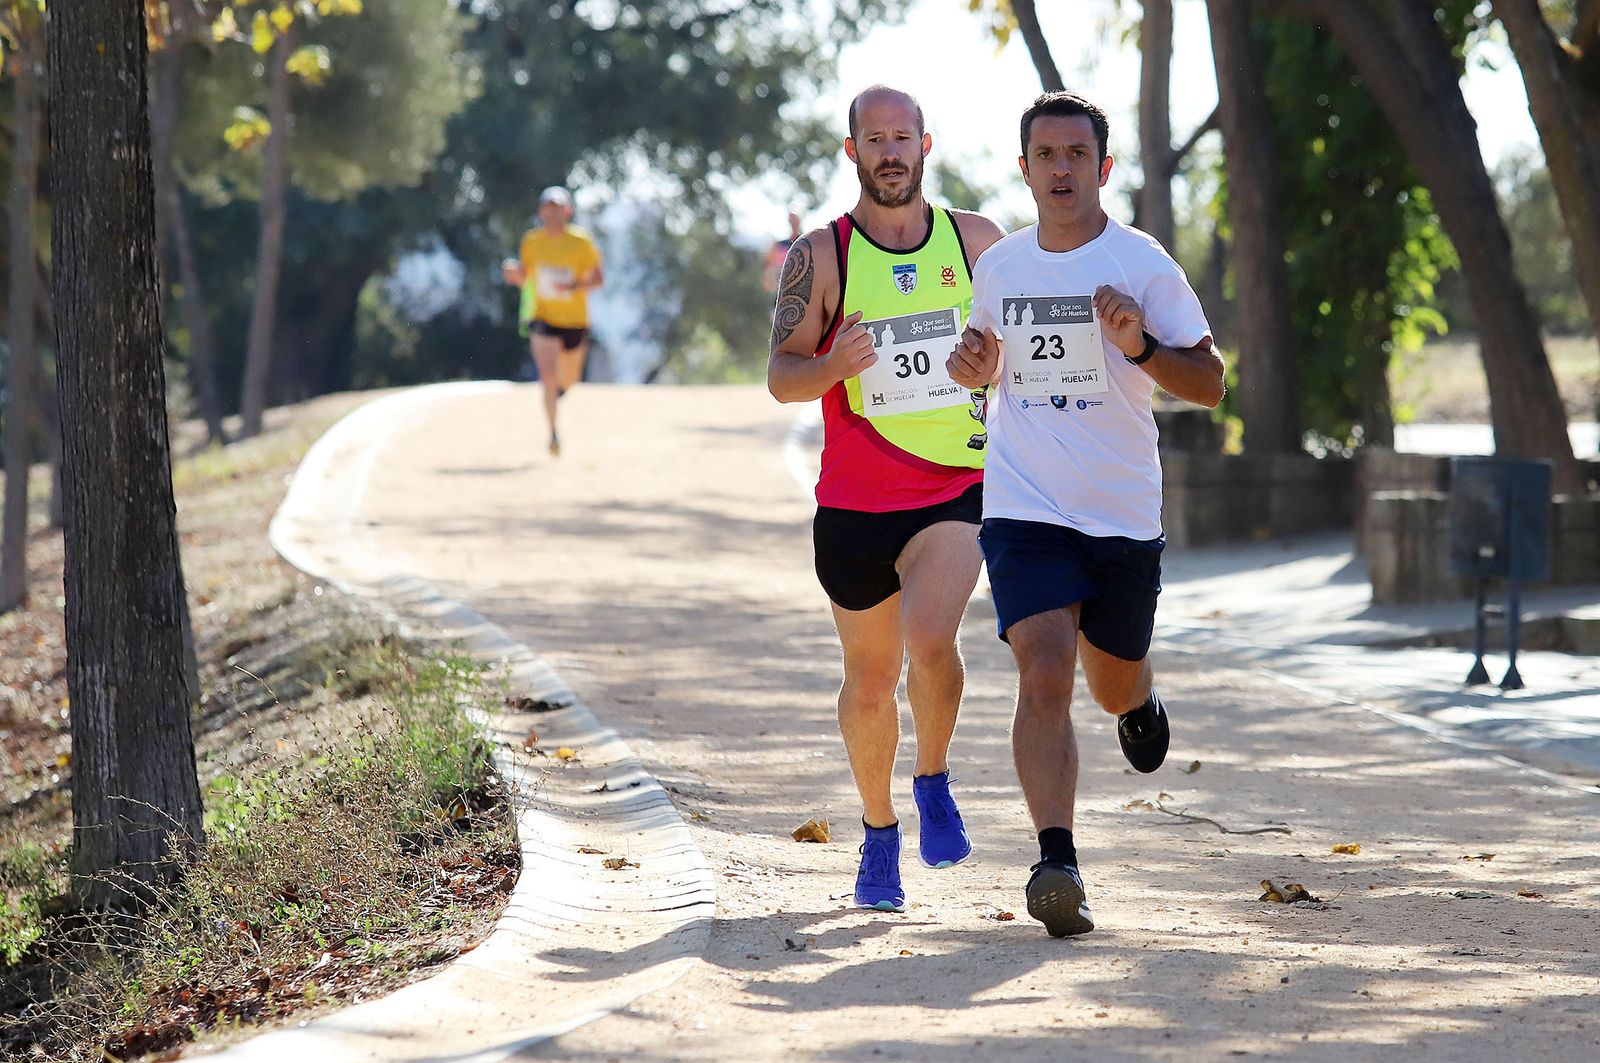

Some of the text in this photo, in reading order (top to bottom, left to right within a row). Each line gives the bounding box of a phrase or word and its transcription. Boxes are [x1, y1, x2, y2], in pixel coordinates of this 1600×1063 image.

[931, 323, 952, 331] Huelva
[1030, 334, 1066, 361] 23
[893, 350, 931, 379] 30
[894, 393, 916, 401] HUELVA
